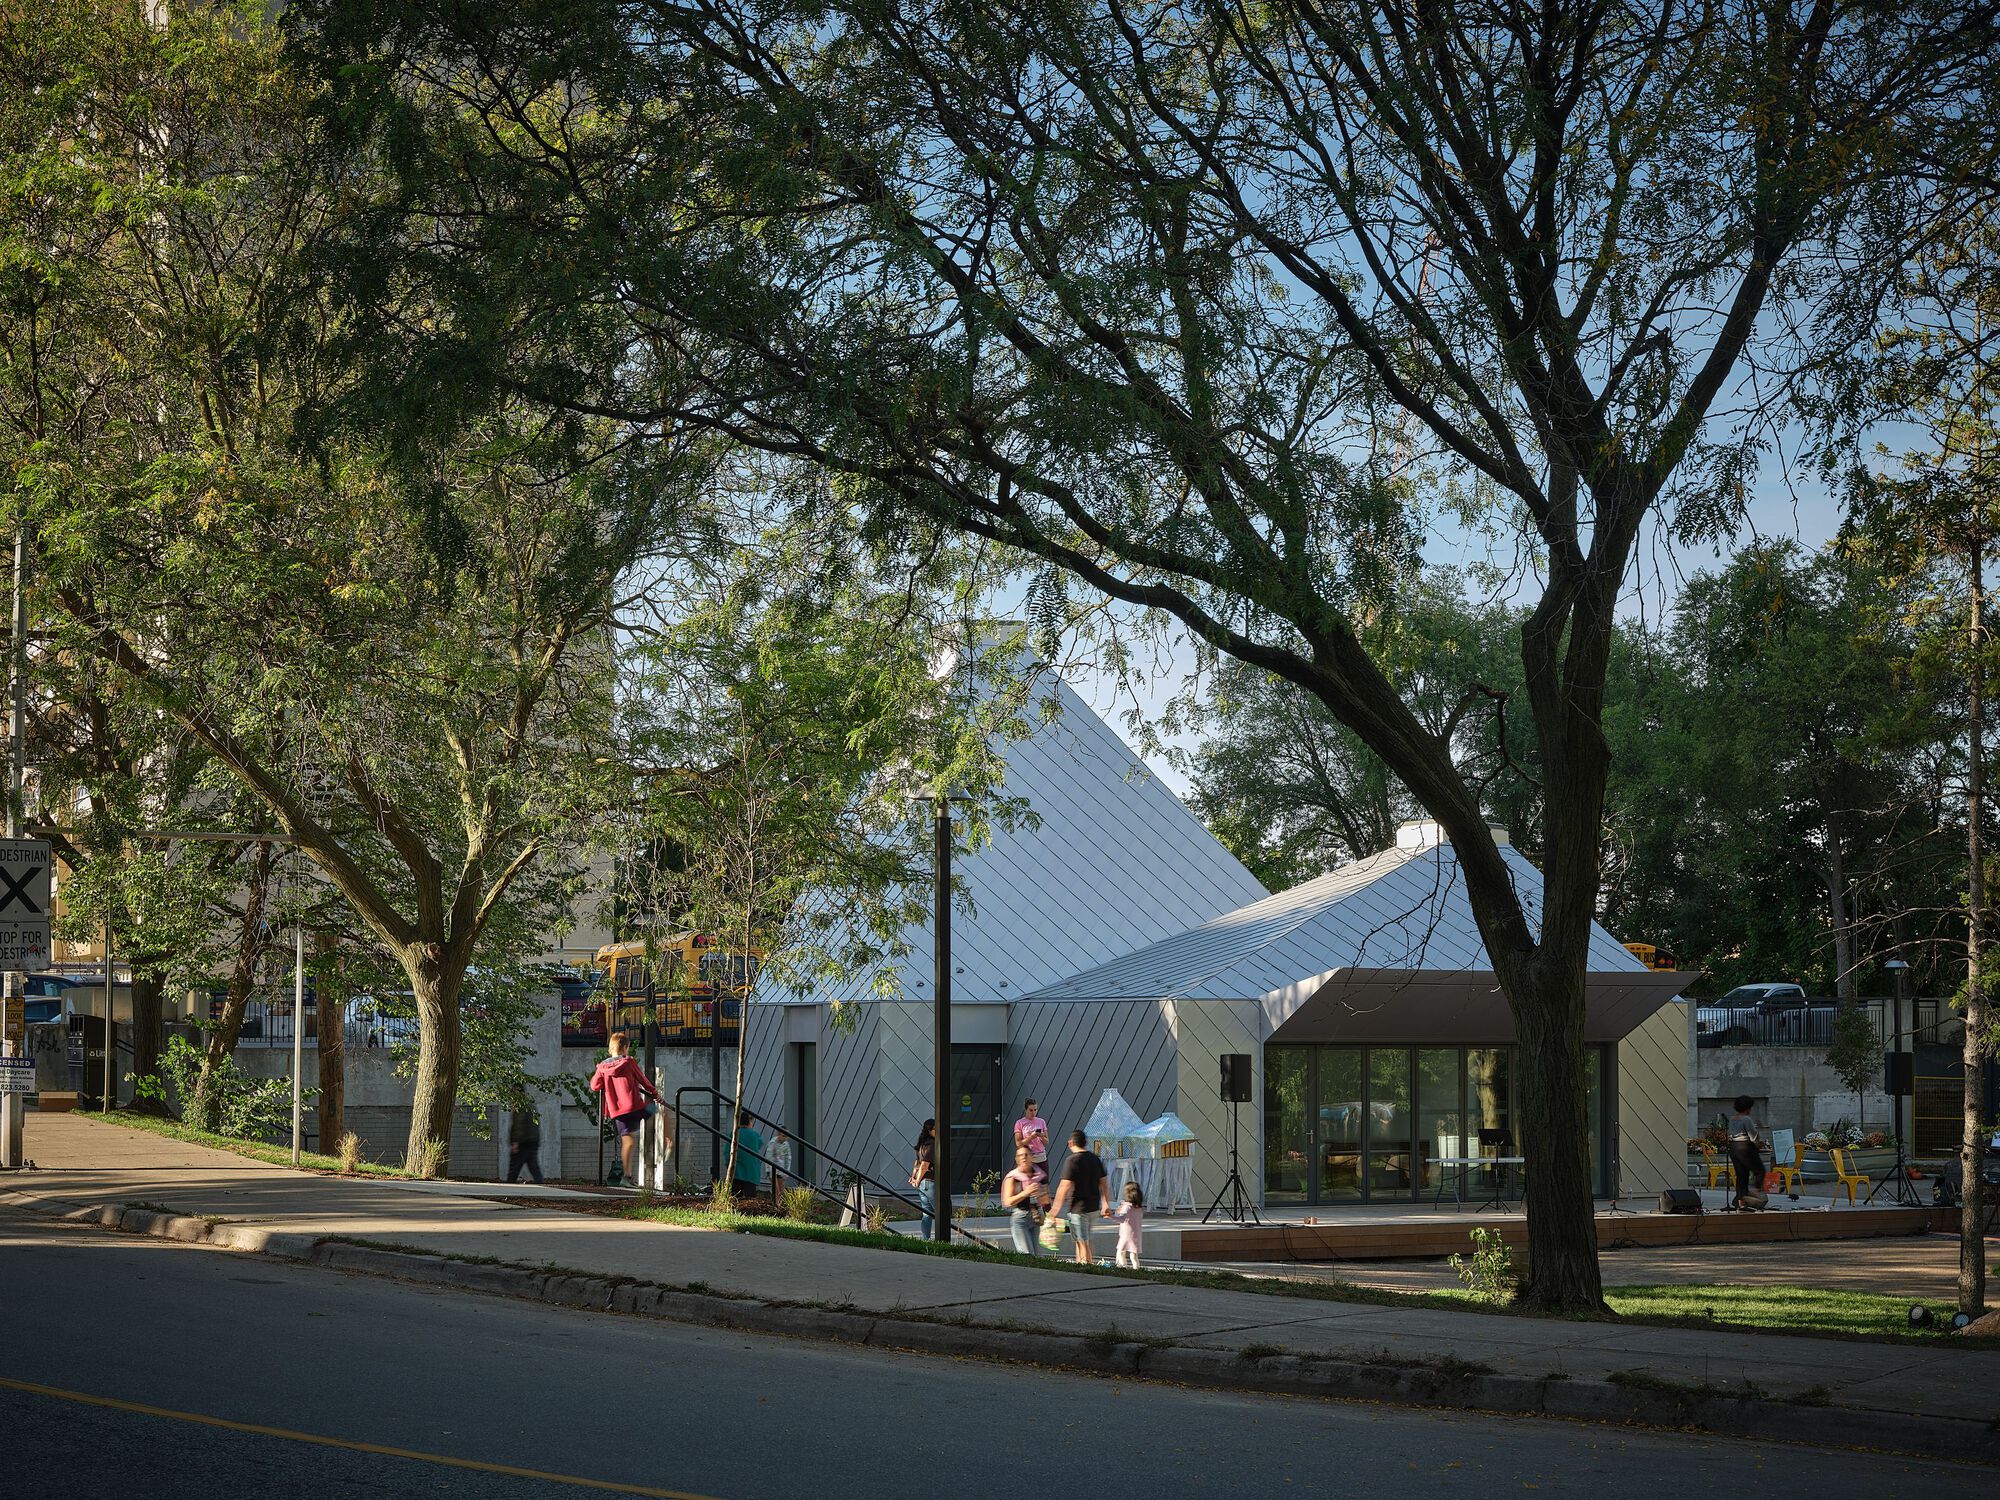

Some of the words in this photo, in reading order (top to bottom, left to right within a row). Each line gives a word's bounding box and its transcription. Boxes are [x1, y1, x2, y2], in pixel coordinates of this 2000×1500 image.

[22, 931, 42, 944] FOR
[1644, 952, 1655, 963] BUS
[7, 1012, 23, 1020] LOOK
[6, 1068, 31, 1076] Daycare
